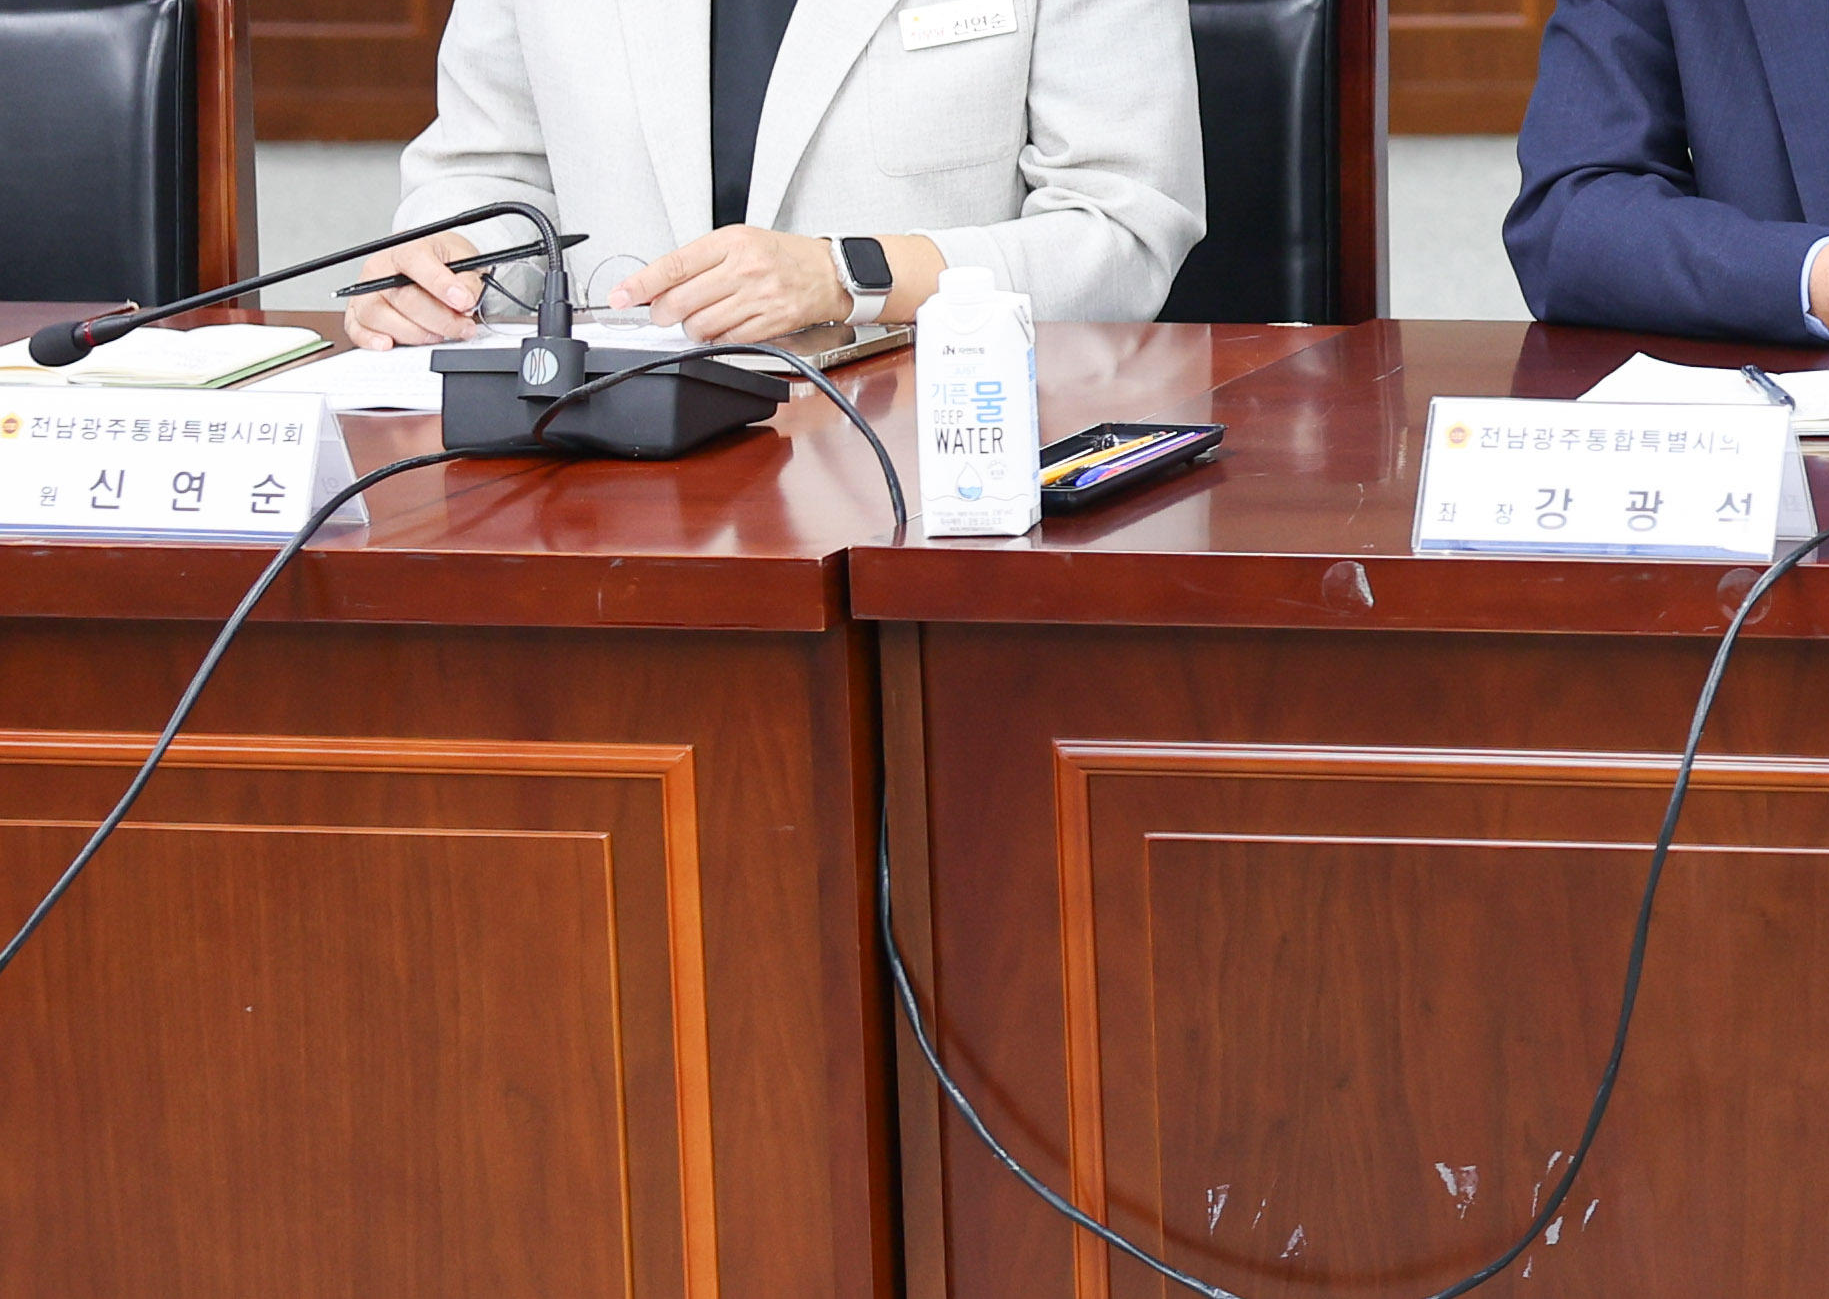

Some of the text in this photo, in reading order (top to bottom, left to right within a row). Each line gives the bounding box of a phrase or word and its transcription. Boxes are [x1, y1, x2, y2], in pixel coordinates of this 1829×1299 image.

[952, 13, 1007, 36] 신연순
[931, 381, 1007, 423] 기픈 물
[934, 410, 964, 425] DEEP
[31, 416, 303, 446] 전남광주통합특별시의회
[935, 427, 1004, 455] WATER
[39, 485, 59, 507] 원
